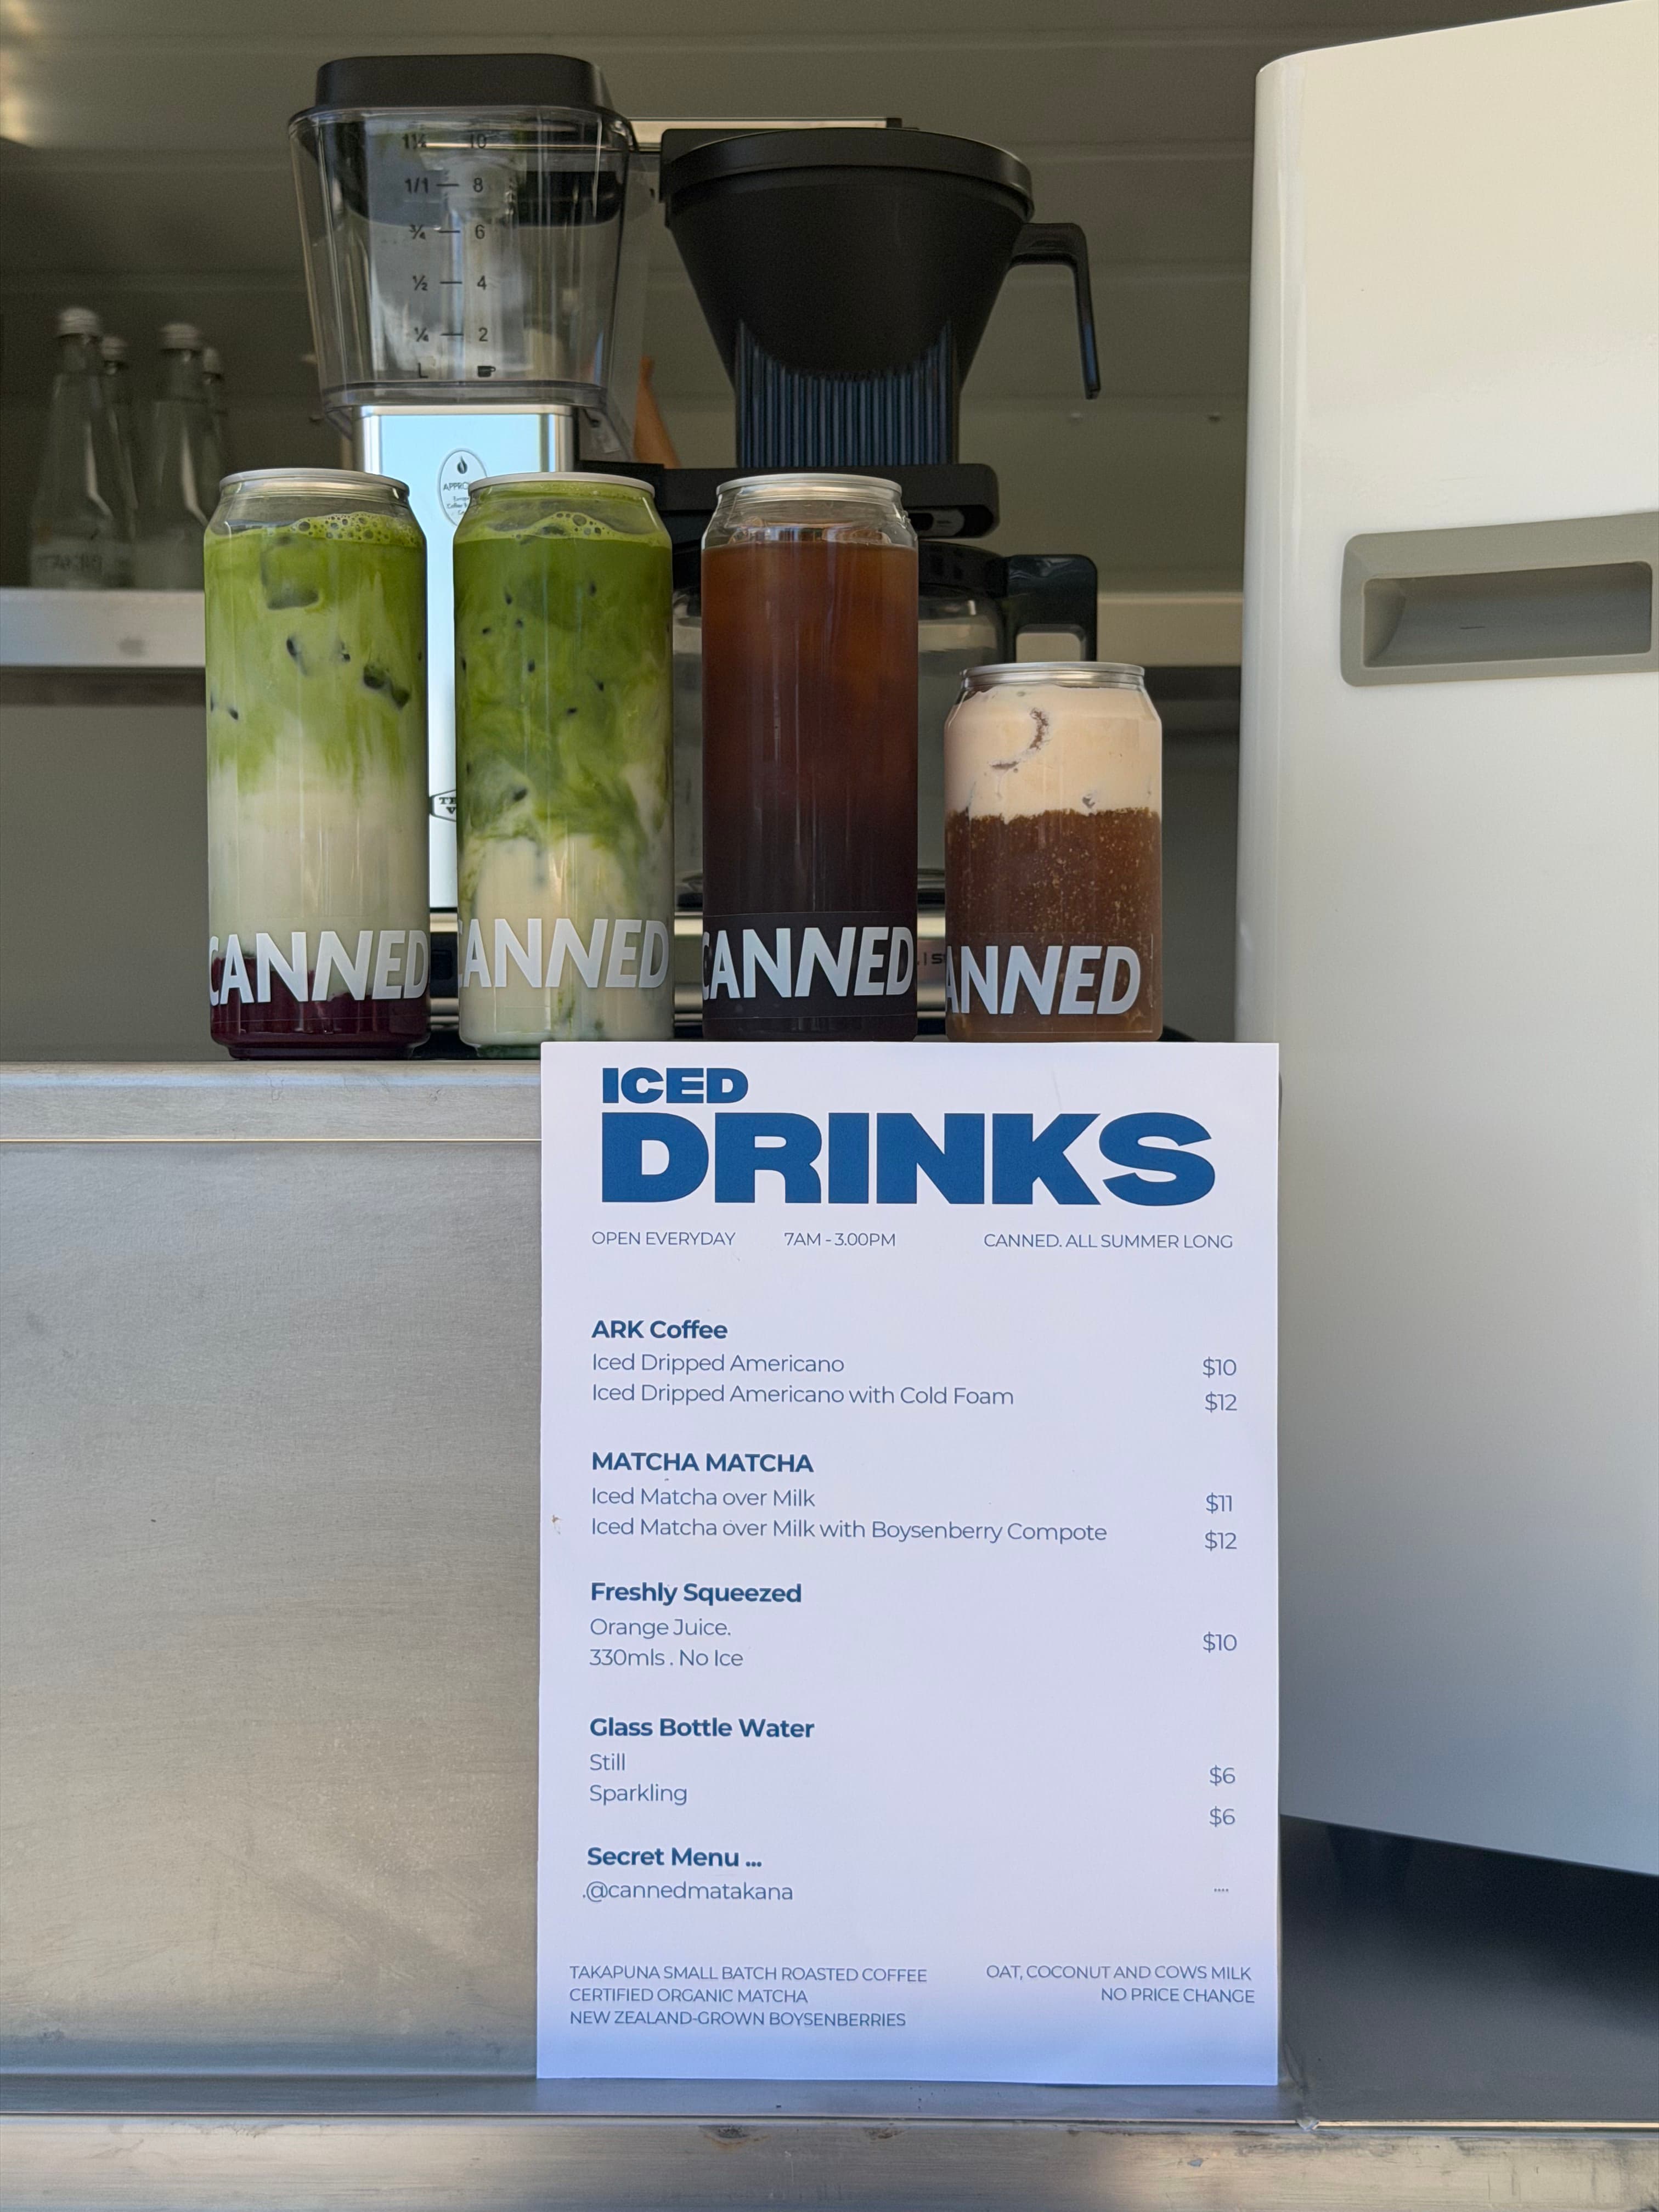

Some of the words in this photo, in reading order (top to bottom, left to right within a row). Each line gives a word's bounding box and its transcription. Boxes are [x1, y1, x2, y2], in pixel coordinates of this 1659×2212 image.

[473, 177, 483, 193] 8
[475, 224, 485, 239] 6
[477, 275, 487, 290] 4
[478, 327, 488, 342] 2
[602, 1067, 749, 1104] ICED
[601, 1111, 1216, 1207] DRINKS
[591, 1231, 641, 1245] OPEN
[646, 1232, 736, 1246] EVERYDAY
[784, 1232, 821, 1246] 7AM
[834, 1232, 895, 1247] 3.00PM
[984, 1233, 1063, 1248] CANNED.
[1065, 1234, 1098, 1248] ALL
[1101, 1234, 1179, 1248] SUMMER
[1184, 1234, 1233, 1249] LONG
[591, 1319, 645, 1339] ARK
[650, 1319, 728, 1339] Coffee
[593, 1352, 635, 1371] Iced
[642, 1353, 725, 1375] Dripped
[730, 1354, 844, 1373] Americano
[1202, 1356, 1237, 1379] $10
[593, 1383, 635, 1401] Iced
[641, 1383, 725, 1406] Dripped
[729, 1385, 844, 1403] Americano
[848, 1385, 895, 1404] with
[900, 1386, 947, 1404] Cold
[954, 1387, 1014, 1405] Foam
[1205, 1391, 1238, 1414] $12
[592, 1452, 701, 1472] MATCHA
[706, 1453, 815, 1473] MATCHA
[592, 1486, 634, 1505] Iced
[641, 1487, 717, 1506] Matcha
[723, 1492, 768, 1506] over
[774, 1488, 816, 1507] Milk
[1205, 1492, 1232, 1515] $11
[592, 1517, 634, 1535] Iced
[641, 1518, 717, 1536] Matcha
[723, 1523, 768, 1537] over
[774, 1519, 816, 1537] Milk
[819, 1520, 865, 1538] with
[872, 1521, 1003, 1544] Boysenberry
[1007, 1522, 1108, 1545] Compote
[1204, 1529, 1237, 1552] $12
[591, 1582, 679, 1606] Freshly
[683, 1583, 802, 1607] Squeezed
[590, 1618, 669, 1640] Orange
[673, 1618, 731, 1636] Juice.
[1203, 1631, 1237, 1654] $10
[589, 1648, 665, 1666] 330mls
[680, 1649, 709, 1666] No
[715, 1649, 744, 1667] Ice
[590, 1717, 653, 1737] Glass
[659, 1717, 733, 1737] Bottle
[738, 1718, 815, 1738] Water
[590, 1752, 625, 1771] Still
[1209, 1764, 1235, 1787] $6
[590, 1783, 687, 1806] Sparkling
[1209, 1805, 1235, 1828] $6
[587, 1847, 665, 1866] Secret
[672, 1847, 739, 1867] Menu
[569, 1965, 661, 1979] TAKAPUNA
[663, 1966, 719, 1980] SMALL
[722, 1966, 777, 1980] BATCH
[782, 1967, 859, 1982] ROASTED
[862, 1968, 927, 1983] COFFEE
[986, 1965, 1023, 1980] OAT,
[1026, 1965, 1111, 1979] COCONUT
[1113, 1966, 1152, 1979] AND
[1154, 1965, 1207, 1979] COWS
[1211, 1966, 1251, 1980] MILK
[569, 1988, 654, 2002] CERTIFIED
[657, 1988, 733, 2003] ORGANIC
[738, 1989, 808, 2004] MATCHA
[1101, 1988, 1127, 2001] NO
[1131, 1988, 1180, 2002] PRICE
[1183, 1988, 1255, 2003] CHANGE
[571, 2011, 611, 2024] NEW
[614, 2011, 764, 2025] ZEALAND-GROWN
[769, 2012, 906, 2027] BOYSENBERRIES
